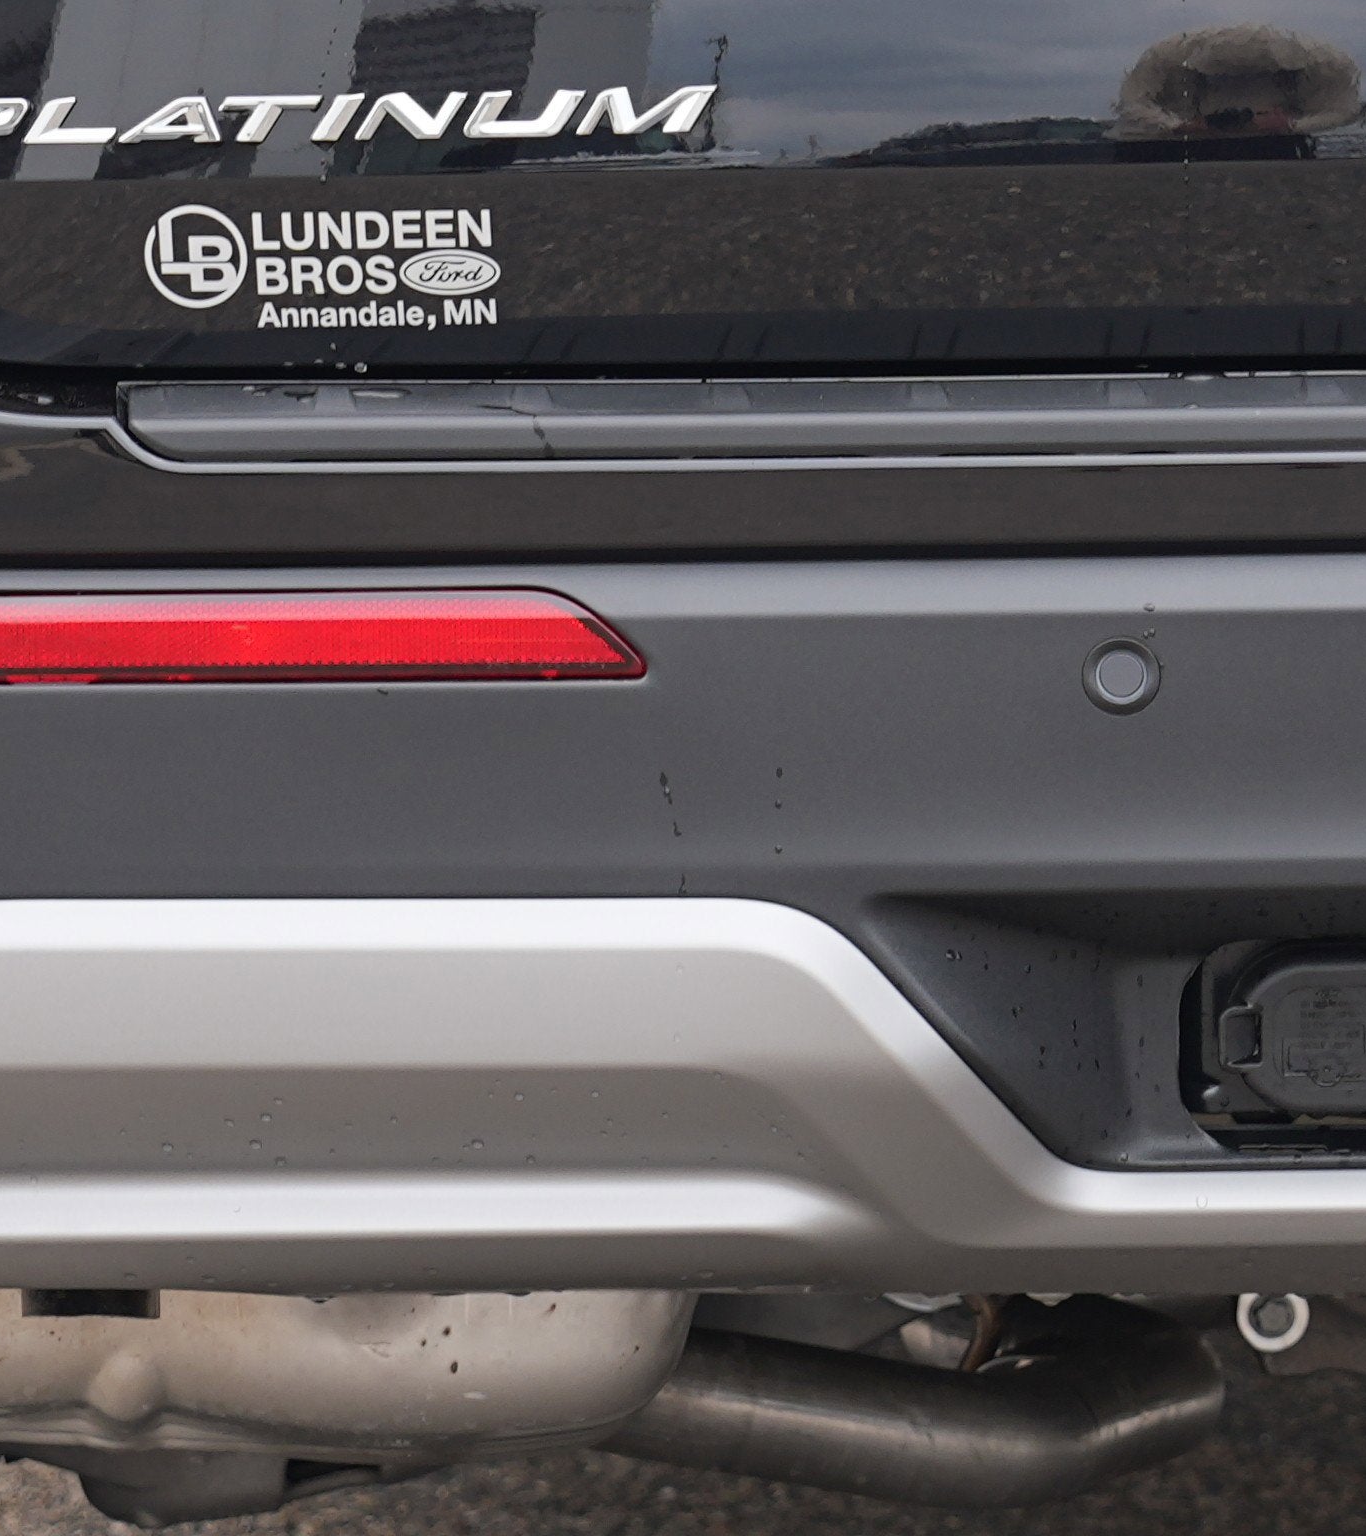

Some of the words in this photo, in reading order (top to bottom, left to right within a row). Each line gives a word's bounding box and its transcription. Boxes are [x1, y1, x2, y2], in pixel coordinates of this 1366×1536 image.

[251, 209, 492, 250] LUNDEEN
[255, 254, 397, 296] BROS
[419, 260, 483, 283] Ford
[257, 299, 437, 331] Annandale,
[443, 298, 497, 325] MN
